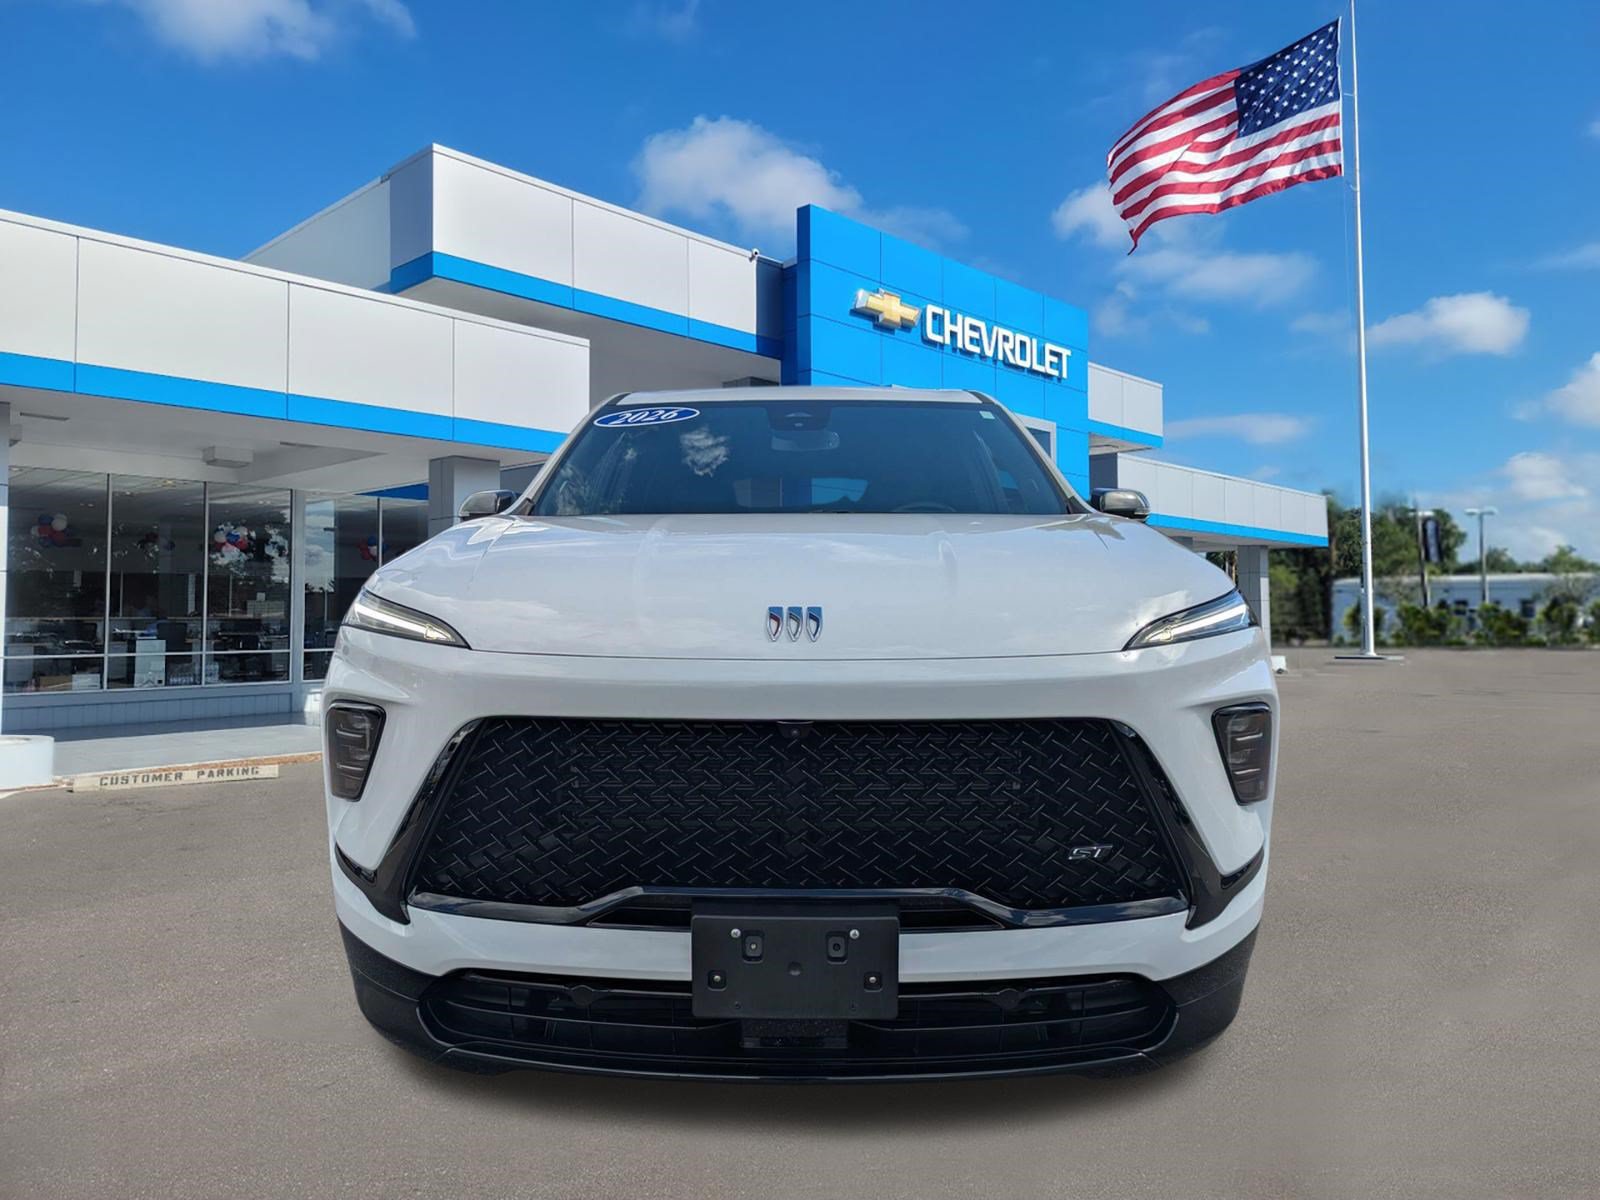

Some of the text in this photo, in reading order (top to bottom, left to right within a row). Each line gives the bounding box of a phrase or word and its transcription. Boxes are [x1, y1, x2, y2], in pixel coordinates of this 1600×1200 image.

[924, 303, 1071, 379] CHEVROLET
[608, 409, 679, 425] 2026
[100, 766, 260, 787] CUSTOMER PARKING
[1068, 844, 1113, 861] ST
